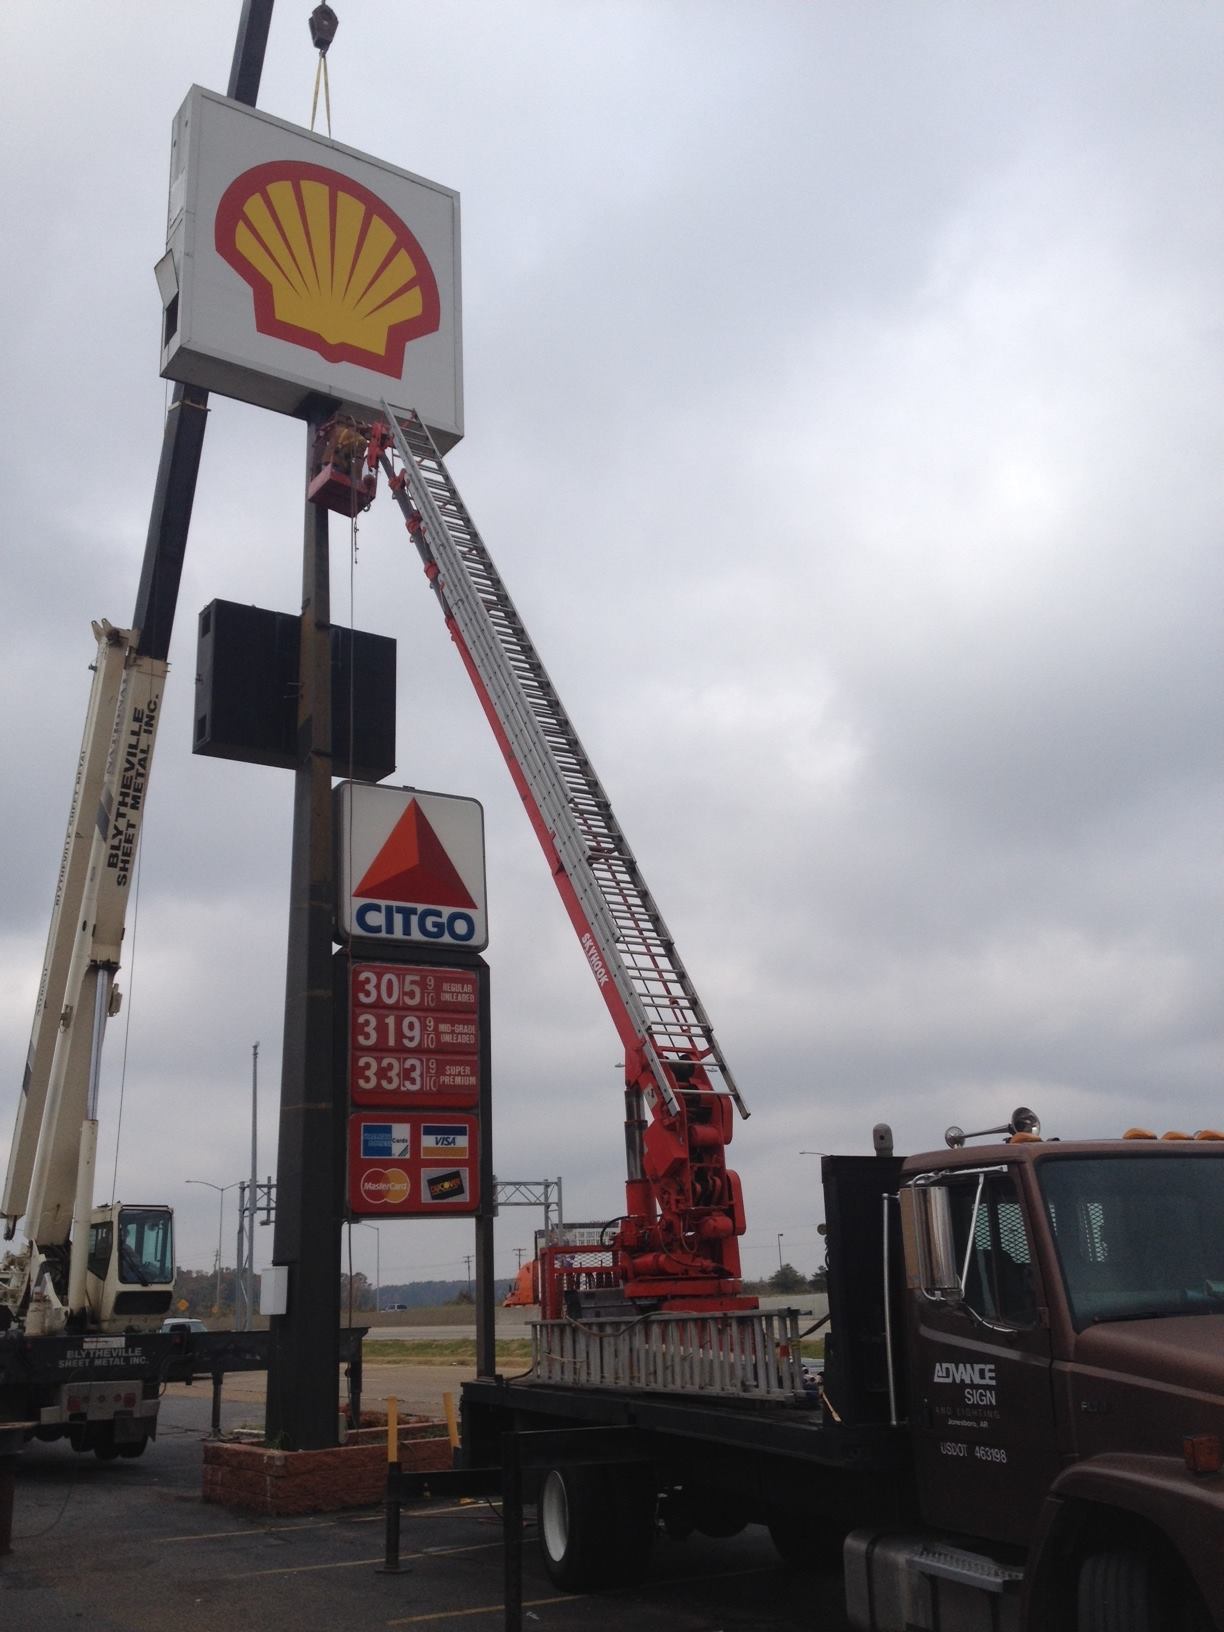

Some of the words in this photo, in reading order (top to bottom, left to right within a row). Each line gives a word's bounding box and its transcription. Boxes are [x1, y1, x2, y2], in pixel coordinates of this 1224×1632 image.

[106, 706, 145, 869] BLYTHEVILLE
[116, 819, 138, 887] SHEET
[129, 744, 151, 811] METAL
[143, 693, 160, 735] INC.
[355, 903, 476, 942] CITGO
[581, 932, 609, 987] SKYHOOK
[442, 982, 473, 993] REGULAR
[440, 992, 475, 1003] UNLEADED
[440, 1033, 475, 1044] UNLEADED
[445, 1065, 471, 1076] SUPER
[439, 1075, 477, 1086] PREMIUM
[434, 1136, 456, 1146] VISA
[363, 1181, 408, 1191] MasterCard
[66, 1347, 143, 1359] BLYTHEVILLE
[58, 1358, 90, 1369] SHEET
[93, 1357, 126, 1367] METAL
[933, 1362, 997, 1386] ADVANCE
[964, 1388, 996, 1406] SIGN
[941, 1442, 968, 1457] USDOT
[974, 1446, 1008, 1463] 463198
